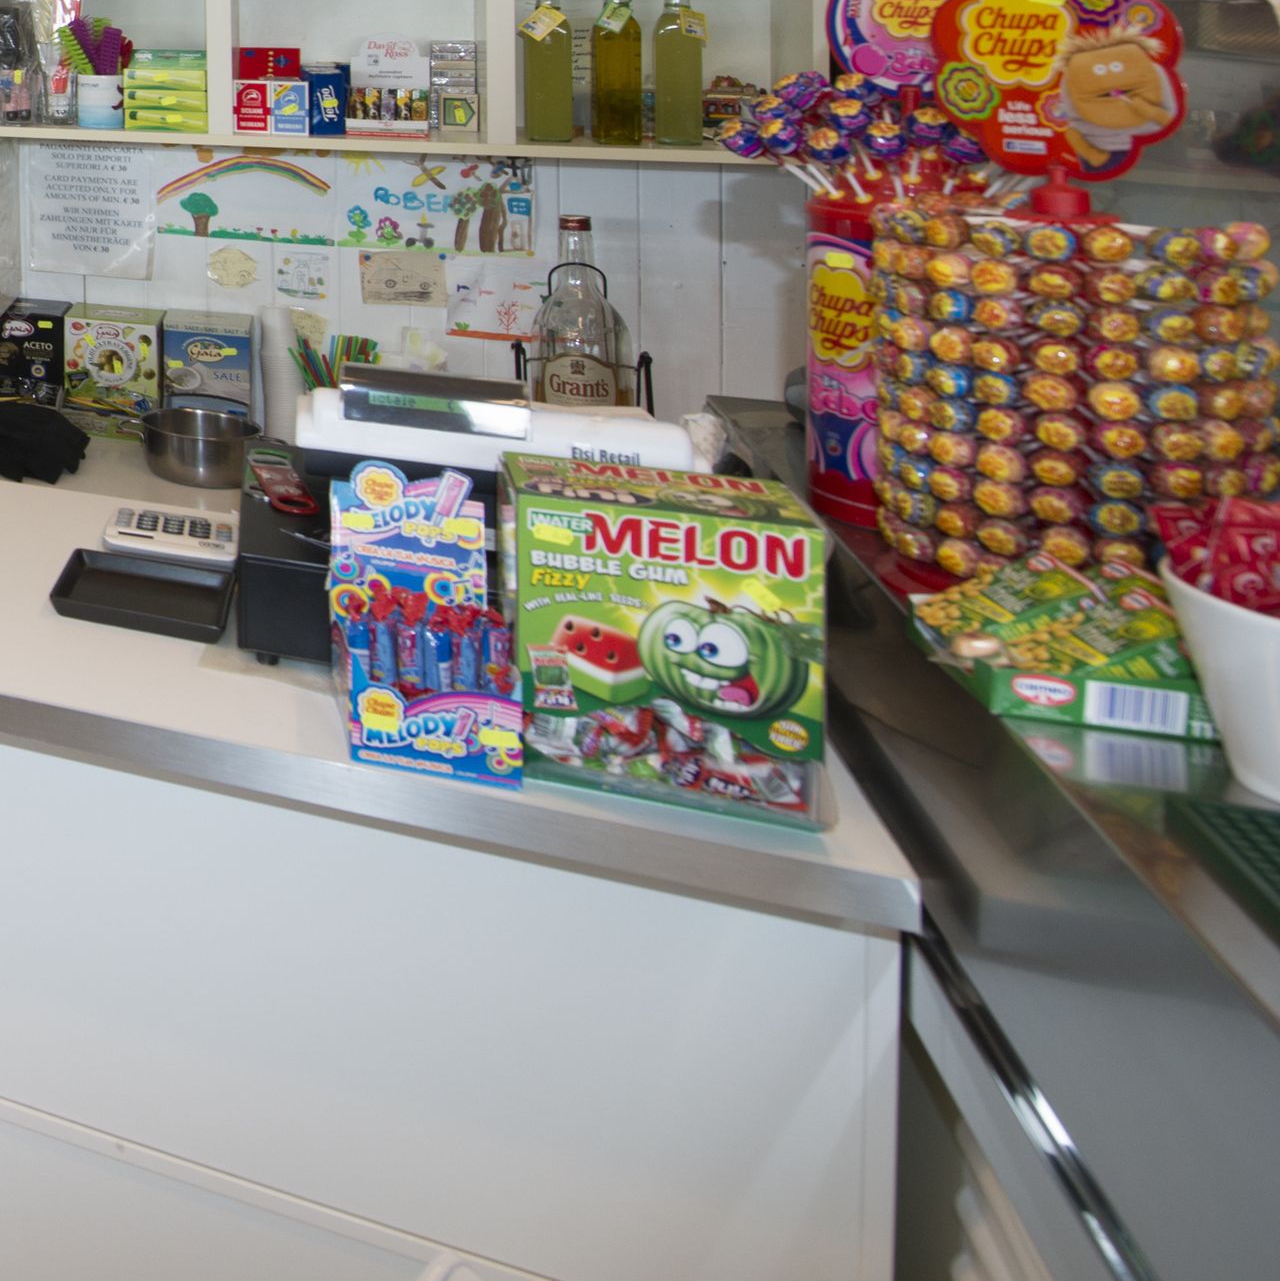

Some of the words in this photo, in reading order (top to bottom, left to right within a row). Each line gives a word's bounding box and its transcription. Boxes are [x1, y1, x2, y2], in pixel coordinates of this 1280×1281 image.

[977, 7, 1058, 36] Chupa
[368, 40, 396, 50] David
[974, 32, 1057, 60] Chups
[384, 48, 408, 60] Ross
[40, 143, 91, 152] PAGAMENTI
[96, 154, 132, 162] IMPORTI
[56, 162, 100, 170] SUPERIORI
[71, 176, 118, 186] PAYMENTS
[46, 184, 91, 192] ACCEPTED
[93, 186, 118, 194] ONLY
[44, 192, 87, 200] AMOUNTS
[82, 208, 120, 216] NEHMEN
[40, 214, 93, 224] ZAHLUNGEN
[114, 220, 144, 228] KARTE
[80, 226, 98, 234] NUR
[100, 227, 118, 235] FÜR
[73, 244, 92, 252] VON
[810, 284, 874, 318] Chupa
[809, 312, 872, 352] Chups
[24, 342, 53, 351] ACETO
[213, 372, 242, 382] SALE
[549, 373, 610, 398] Grant's
[599, 449, 640, 466] Retail
[572, 462, 766, 494] MELON
[404, 522, 456, 540] POPS
[532, 512, 593, 532] WATER
[584, 512, 806, 578] MELON
[530, 550, 622, 576] BUBBLE
[628, 564, 688, 586] GUM
[531, 570, 591, 590] Fizzy
[524, 597, 550, 612] WITH
